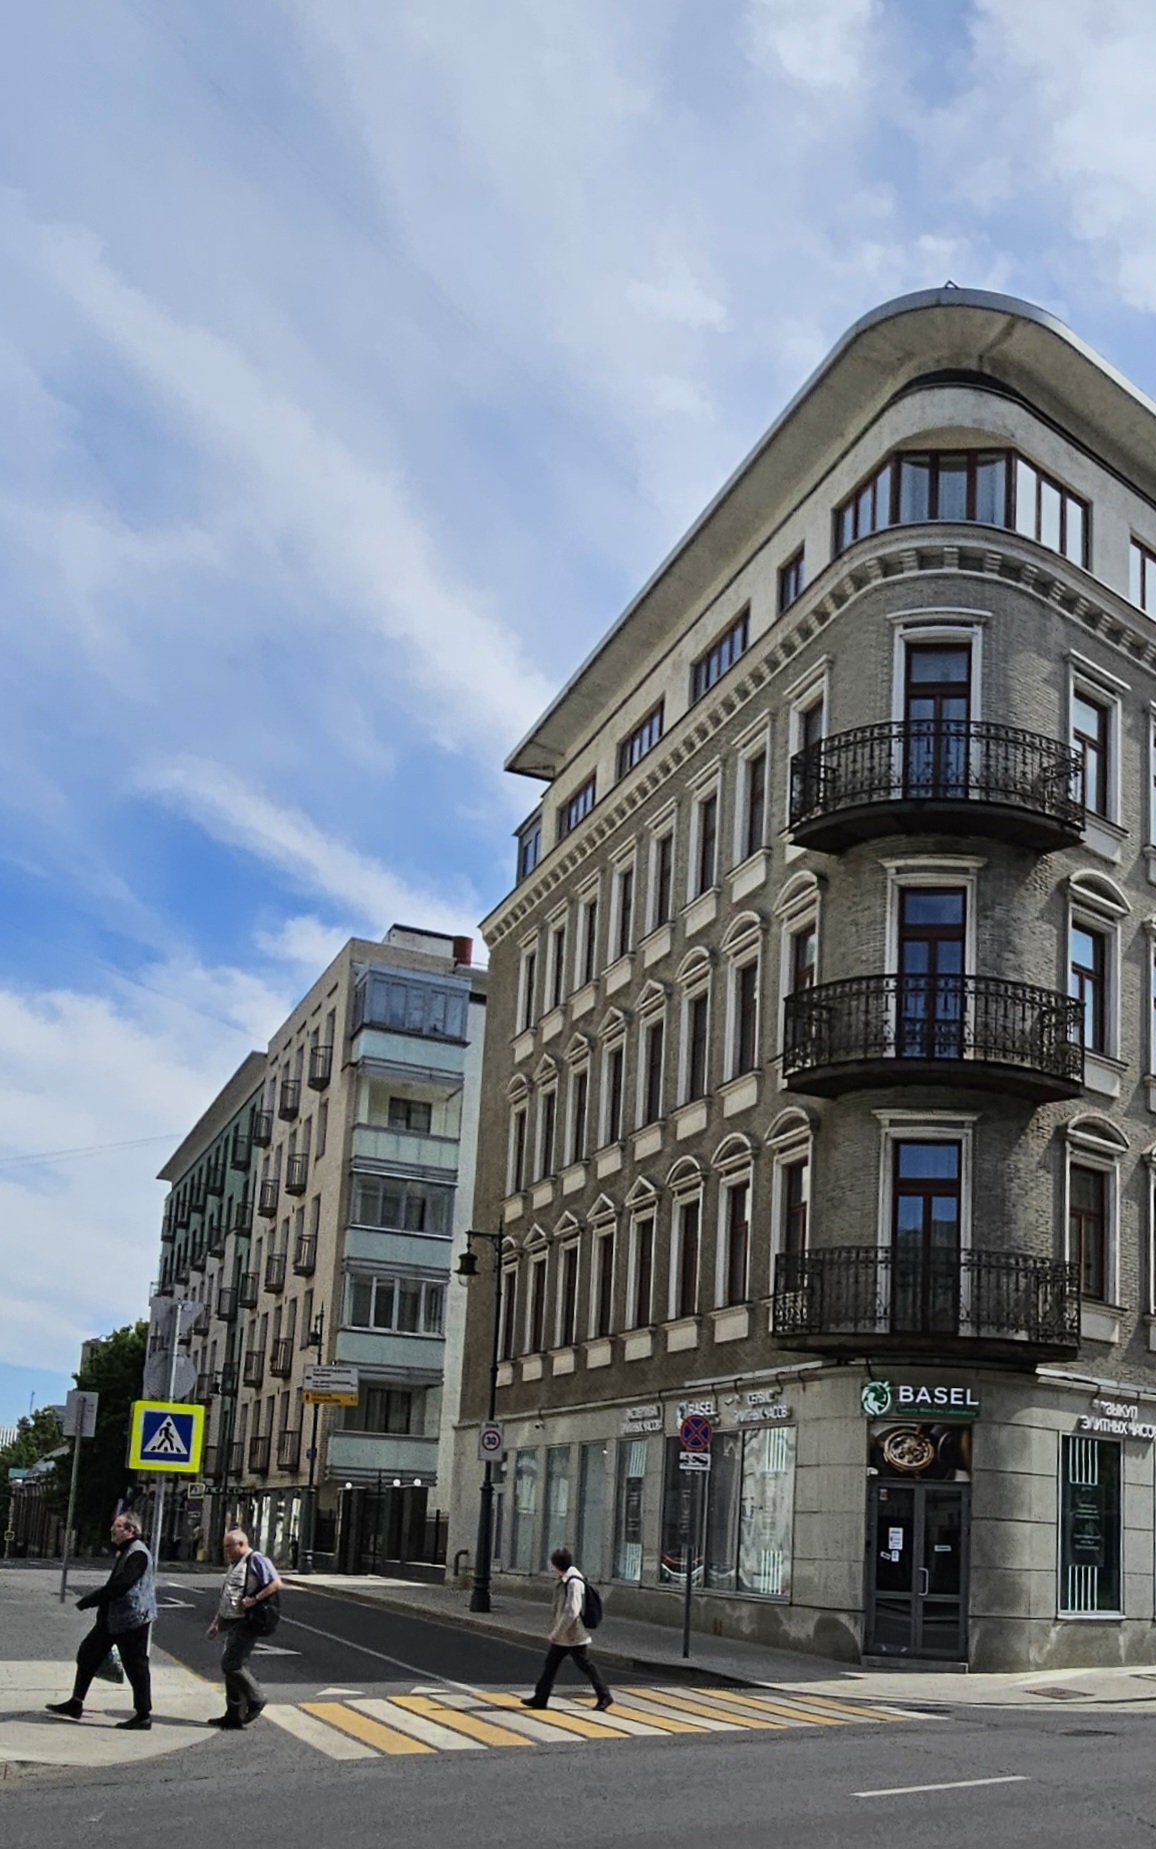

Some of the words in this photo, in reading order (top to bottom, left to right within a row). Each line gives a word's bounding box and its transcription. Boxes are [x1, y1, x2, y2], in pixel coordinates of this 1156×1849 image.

[898, 1385, 979, 1406] BASEL
[1104, 1402, 1138, 1420] ВЫКУП
[1079, 1415, 1128, 1435] ЭЛИТНЫХ
